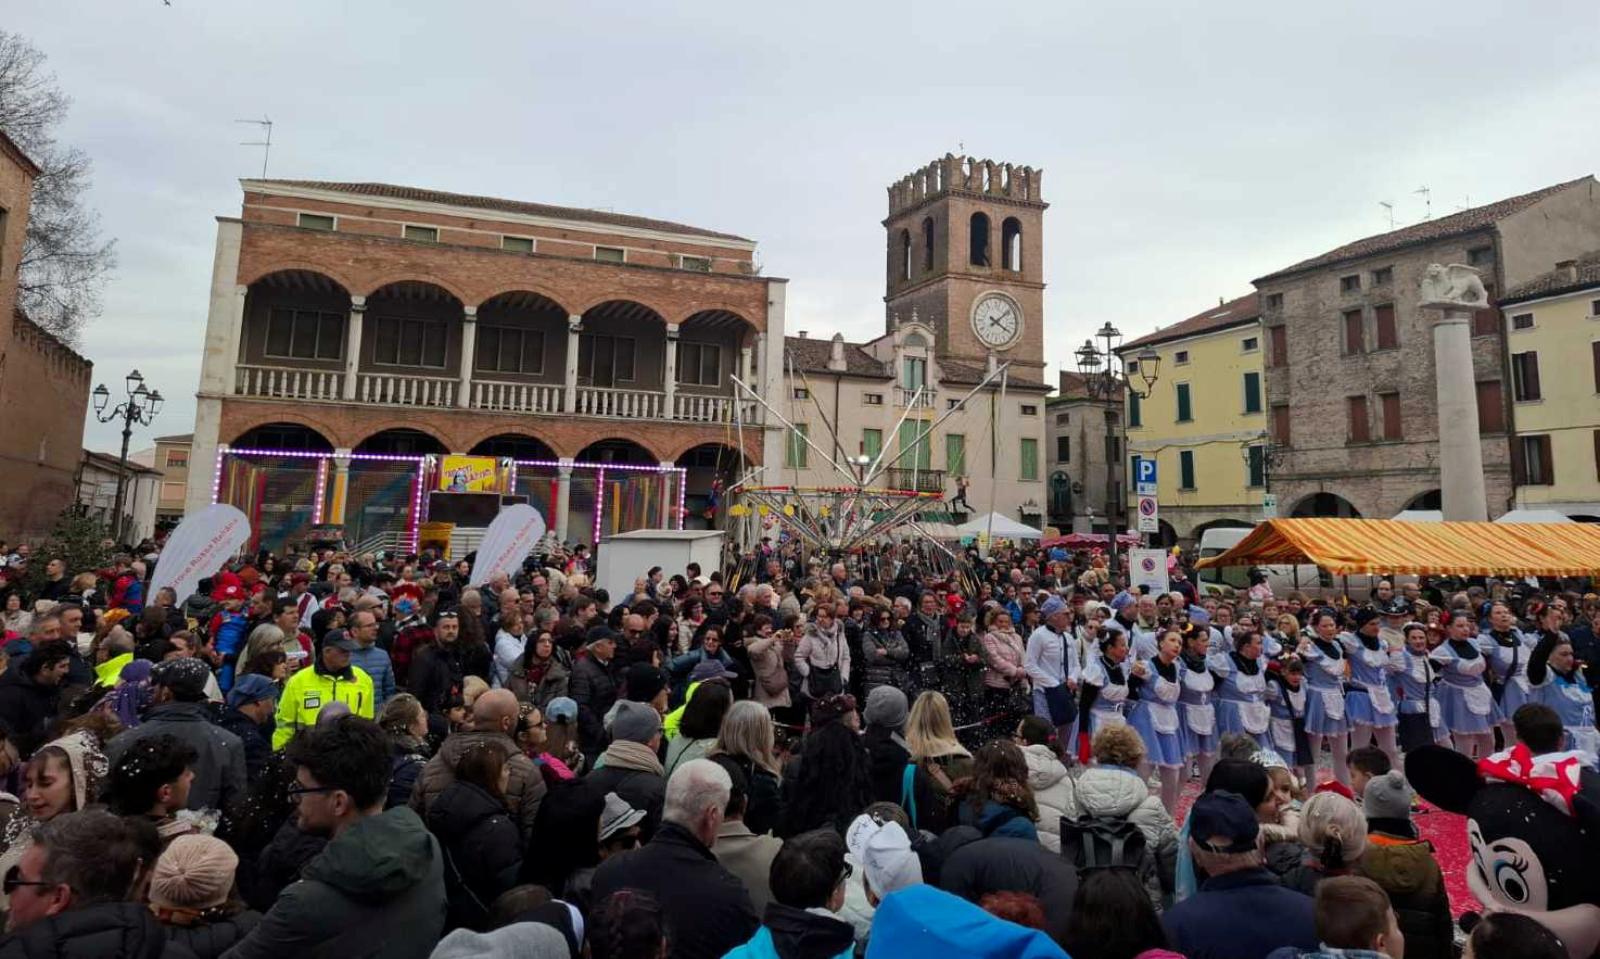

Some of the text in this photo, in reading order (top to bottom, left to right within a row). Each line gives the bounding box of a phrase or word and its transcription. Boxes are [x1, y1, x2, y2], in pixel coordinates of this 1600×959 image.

[1141, 461, 1153, 480] P
[190, 543, 214, 567] Rossa
[211, 518, 239, 545] Italiana
